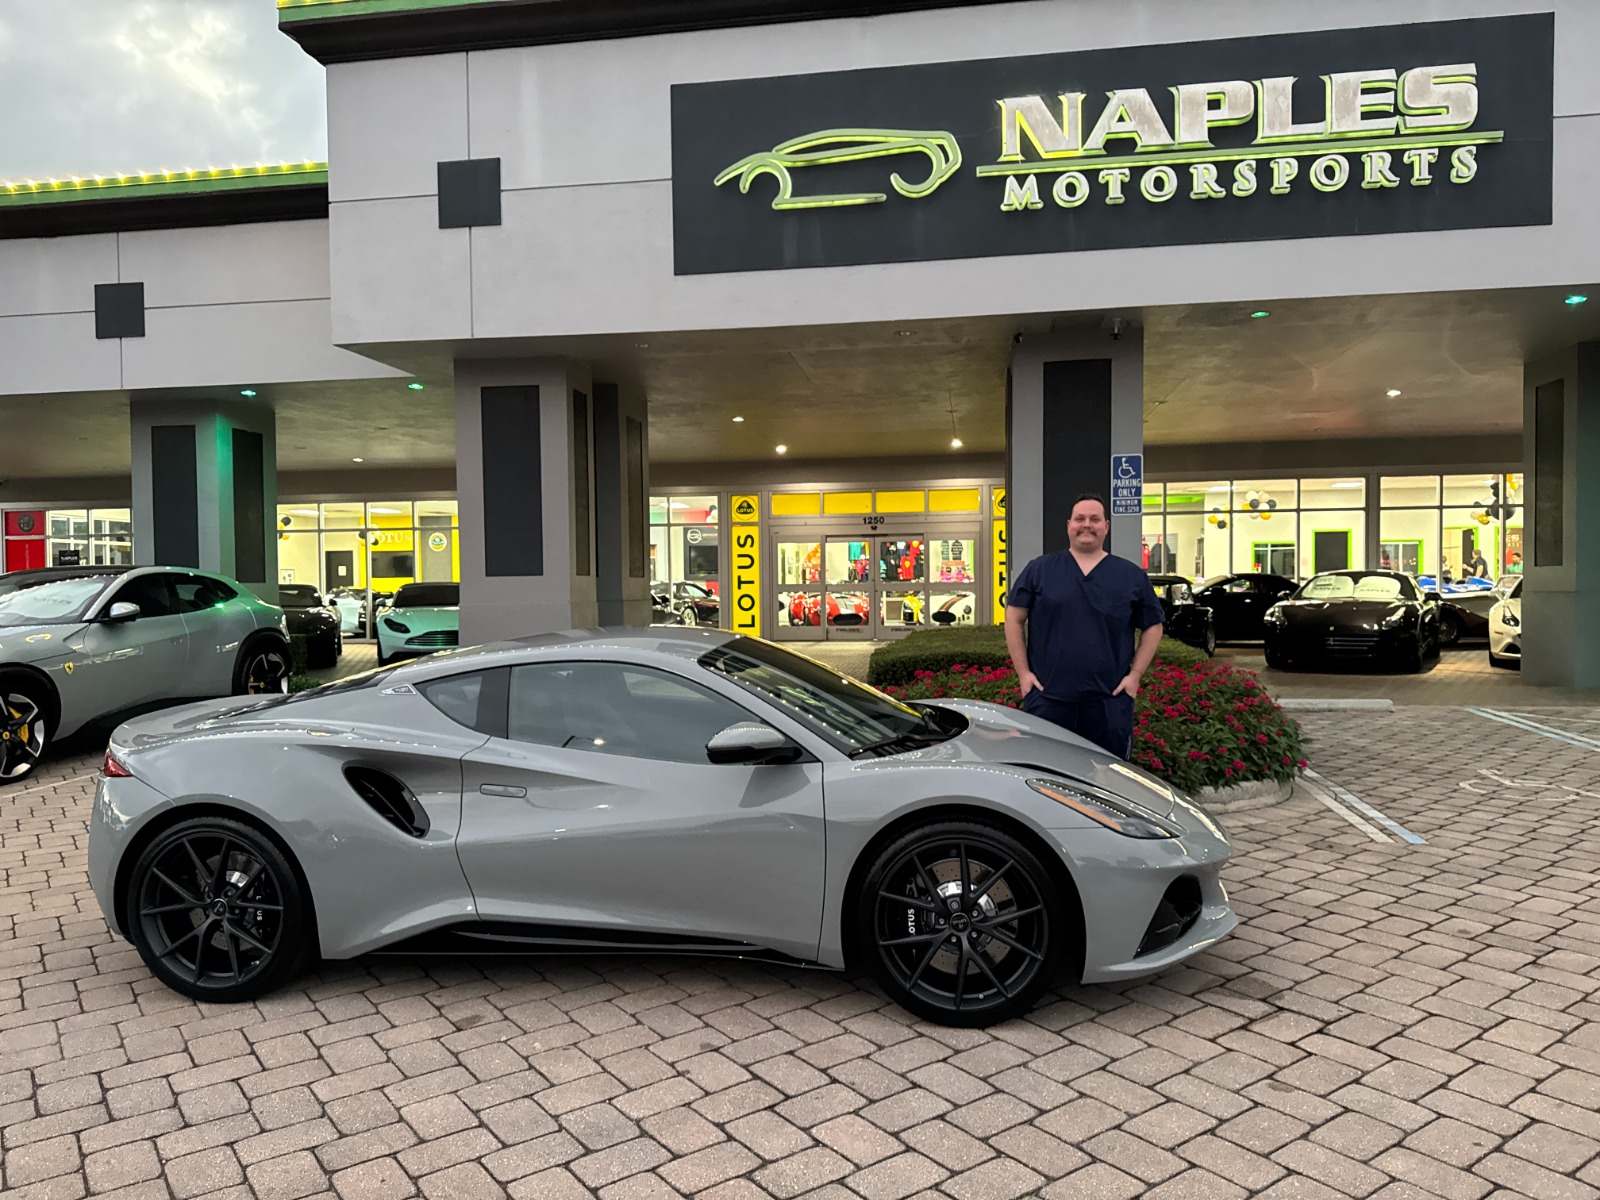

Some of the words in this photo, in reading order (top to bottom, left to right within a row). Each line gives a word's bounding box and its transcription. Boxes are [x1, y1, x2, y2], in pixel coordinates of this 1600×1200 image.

[996, 63, 1478, 161] NAPLES
[1000, 145, 1477, 211] MOTORSPORTS
[1113, 478, 1141, 488] PARKING
[1118, 487, 1136, 497] ONLY
[863, 516, 885, 525] 1250
[737, 534, 755, 628] LOTUS
[907, 908, 916, 935] OTUS
